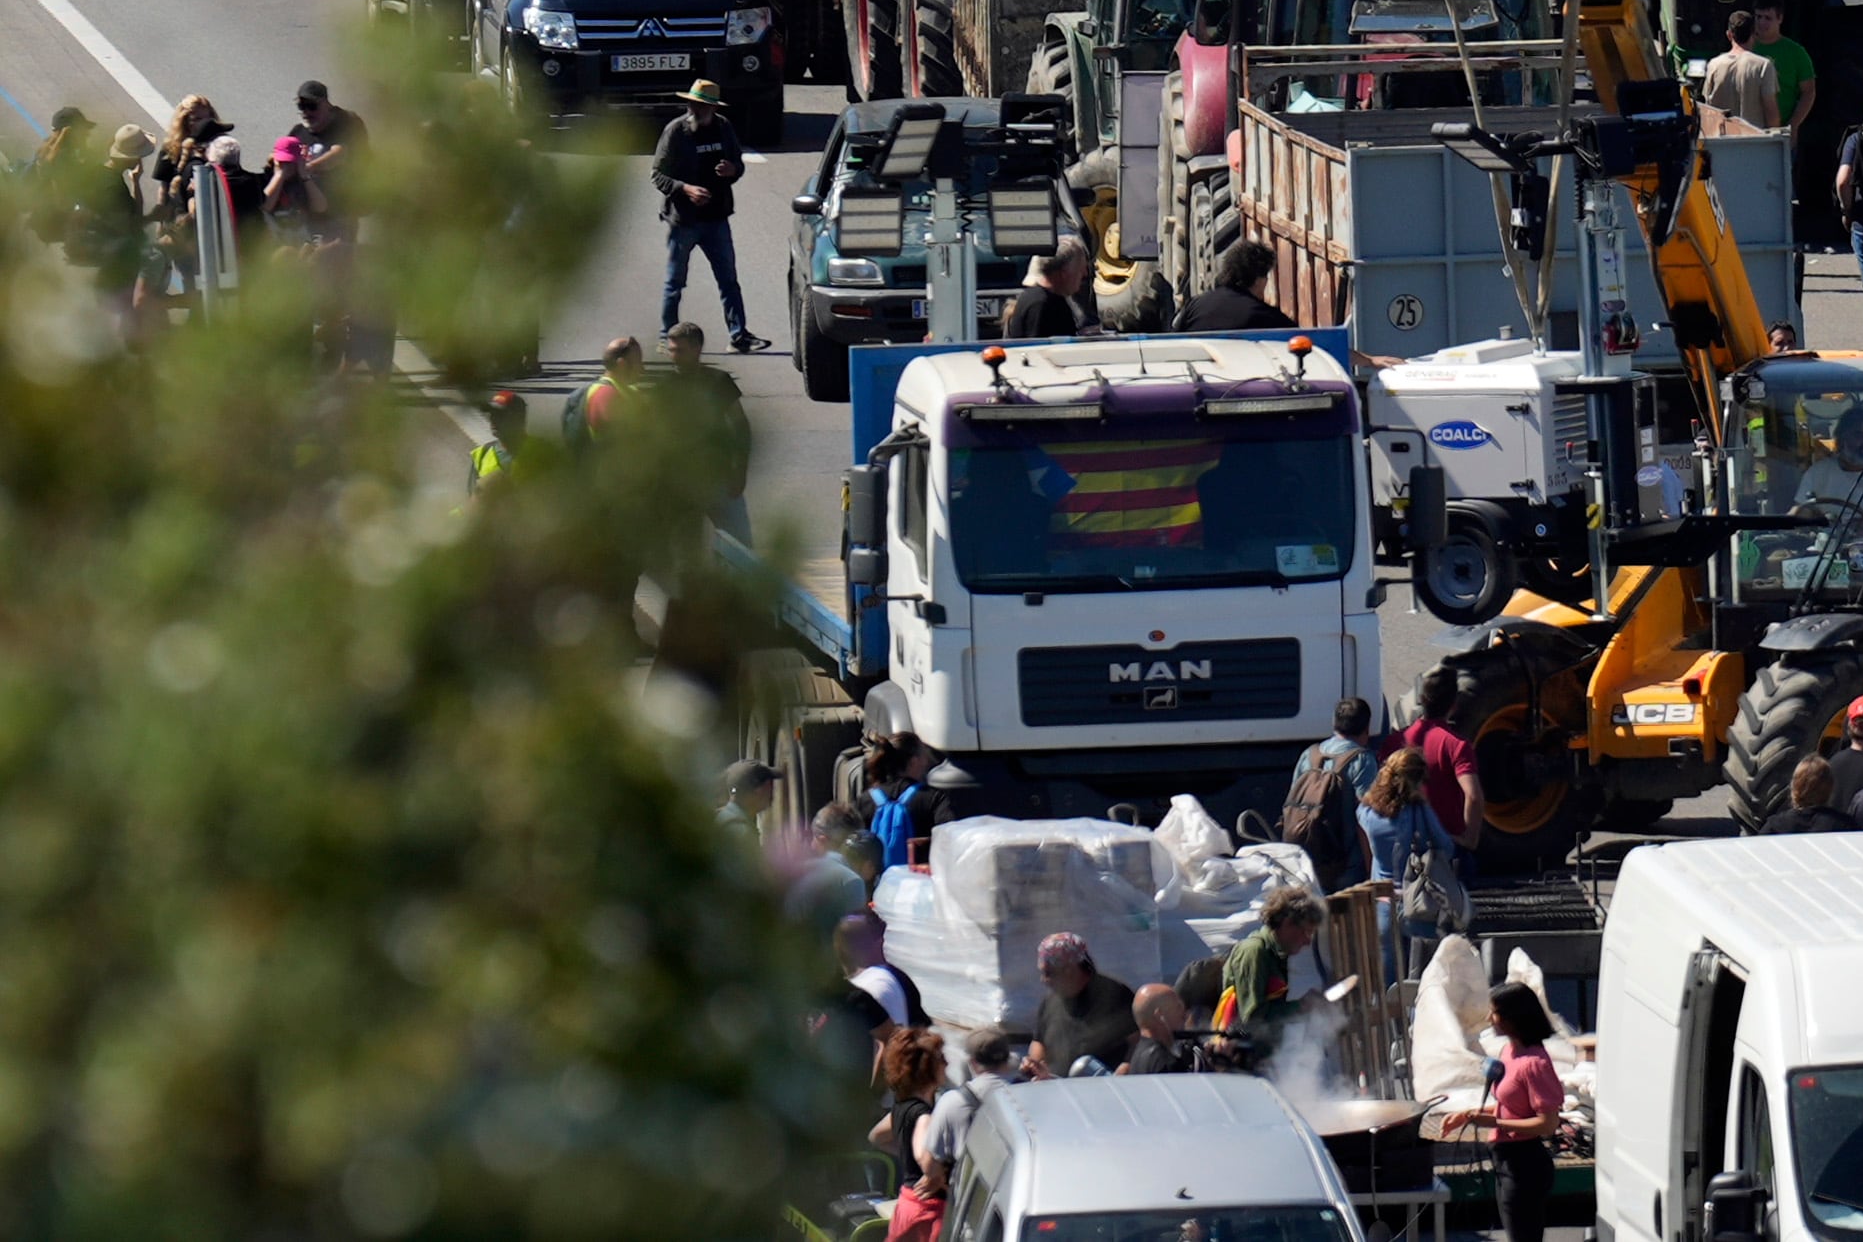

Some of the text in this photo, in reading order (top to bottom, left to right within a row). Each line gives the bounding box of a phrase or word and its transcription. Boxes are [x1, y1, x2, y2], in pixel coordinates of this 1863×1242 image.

[622, 56, 687, 69] 3895 FLZ
[1396, 299, 1417, 326] 25
[1109, 660, 1211, 682] MAN
